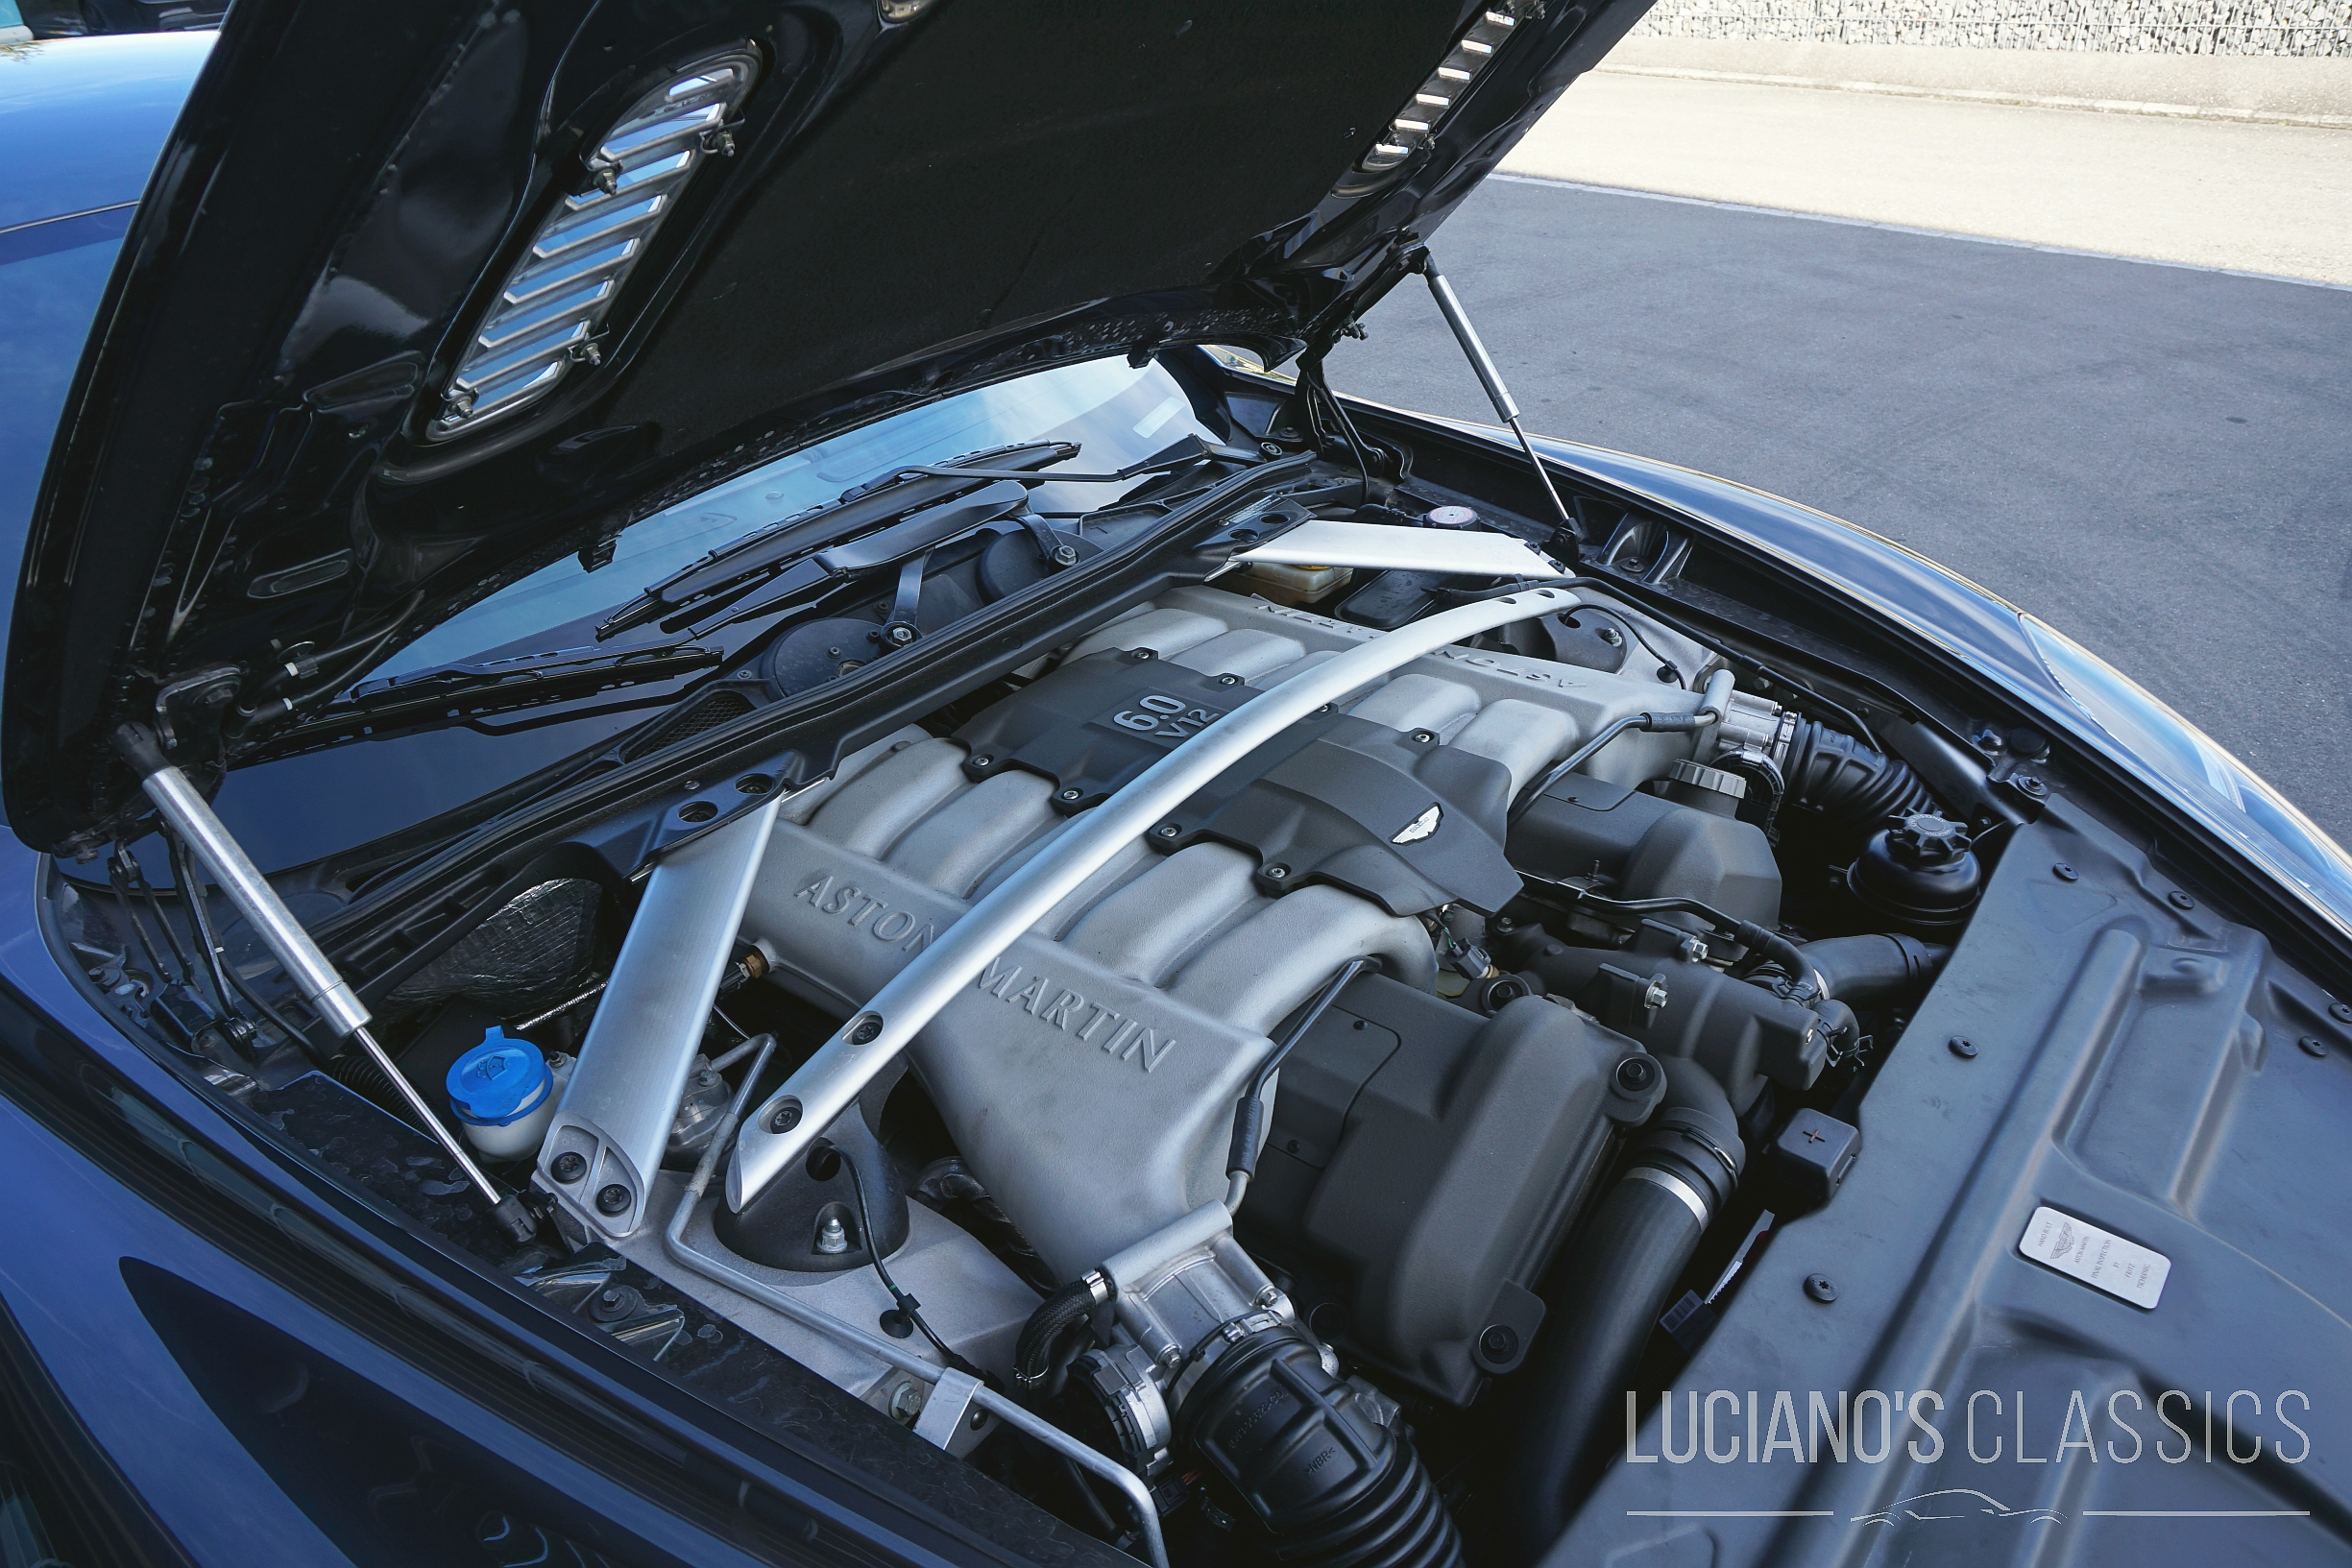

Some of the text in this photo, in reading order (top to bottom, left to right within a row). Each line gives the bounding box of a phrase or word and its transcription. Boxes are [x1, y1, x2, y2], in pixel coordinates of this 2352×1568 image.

[1113, 694, 1187, 731] 6.0
[1154, 708, 1220, 738] V12
[978, 956, 1177, 1074] MARTIN
[2037, 1233, 2048, 1248] HAND
[2091, 1265, 2102, 1280] FINAL
[2124, 1263, 2136, 1279] FRITZ
